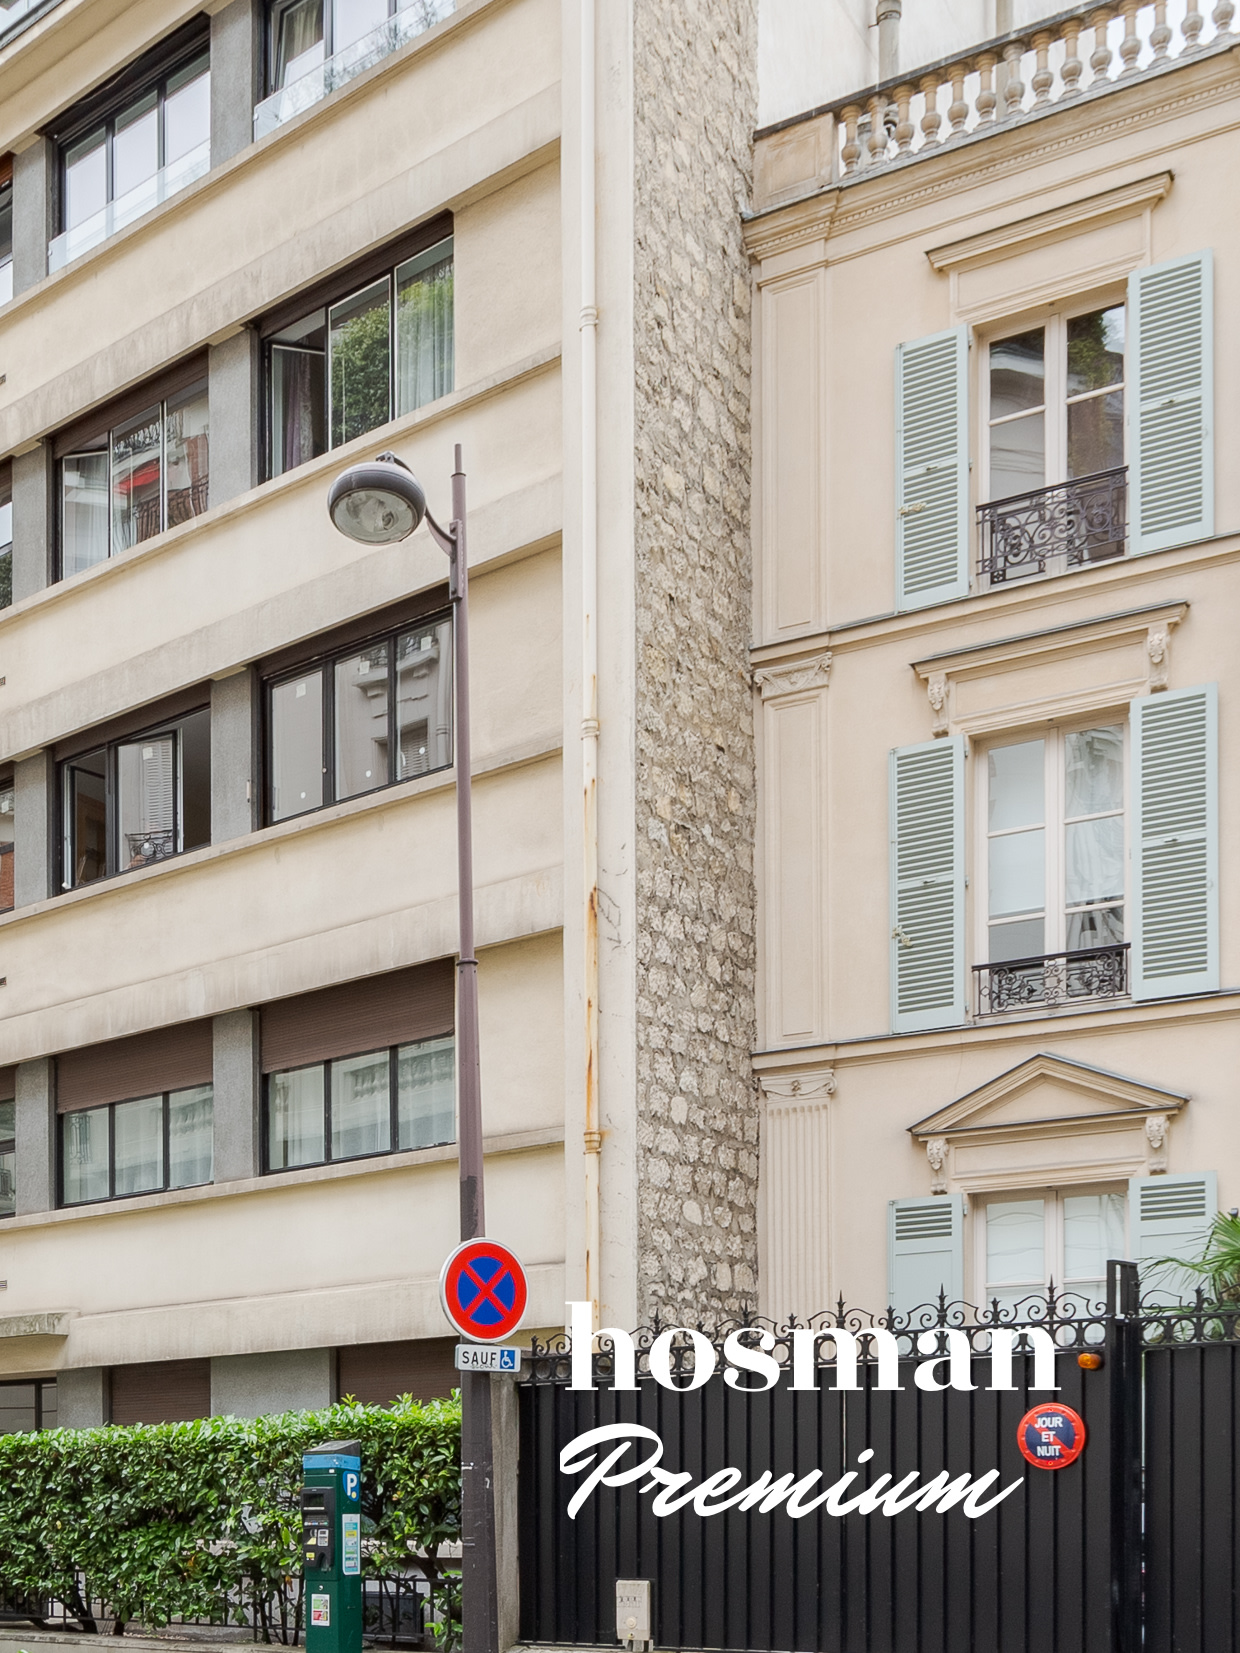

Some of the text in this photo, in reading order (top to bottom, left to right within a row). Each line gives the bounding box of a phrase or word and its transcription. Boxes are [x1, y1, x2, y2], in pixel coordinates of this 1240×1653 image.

[462, 1351, 497, 1366] SAUF
[1034, 1416, 1063, 1428] JOUR
[1041, 1431, 1056, 1442] ET
[1036, 1445, 1061, 1457] NUIT
